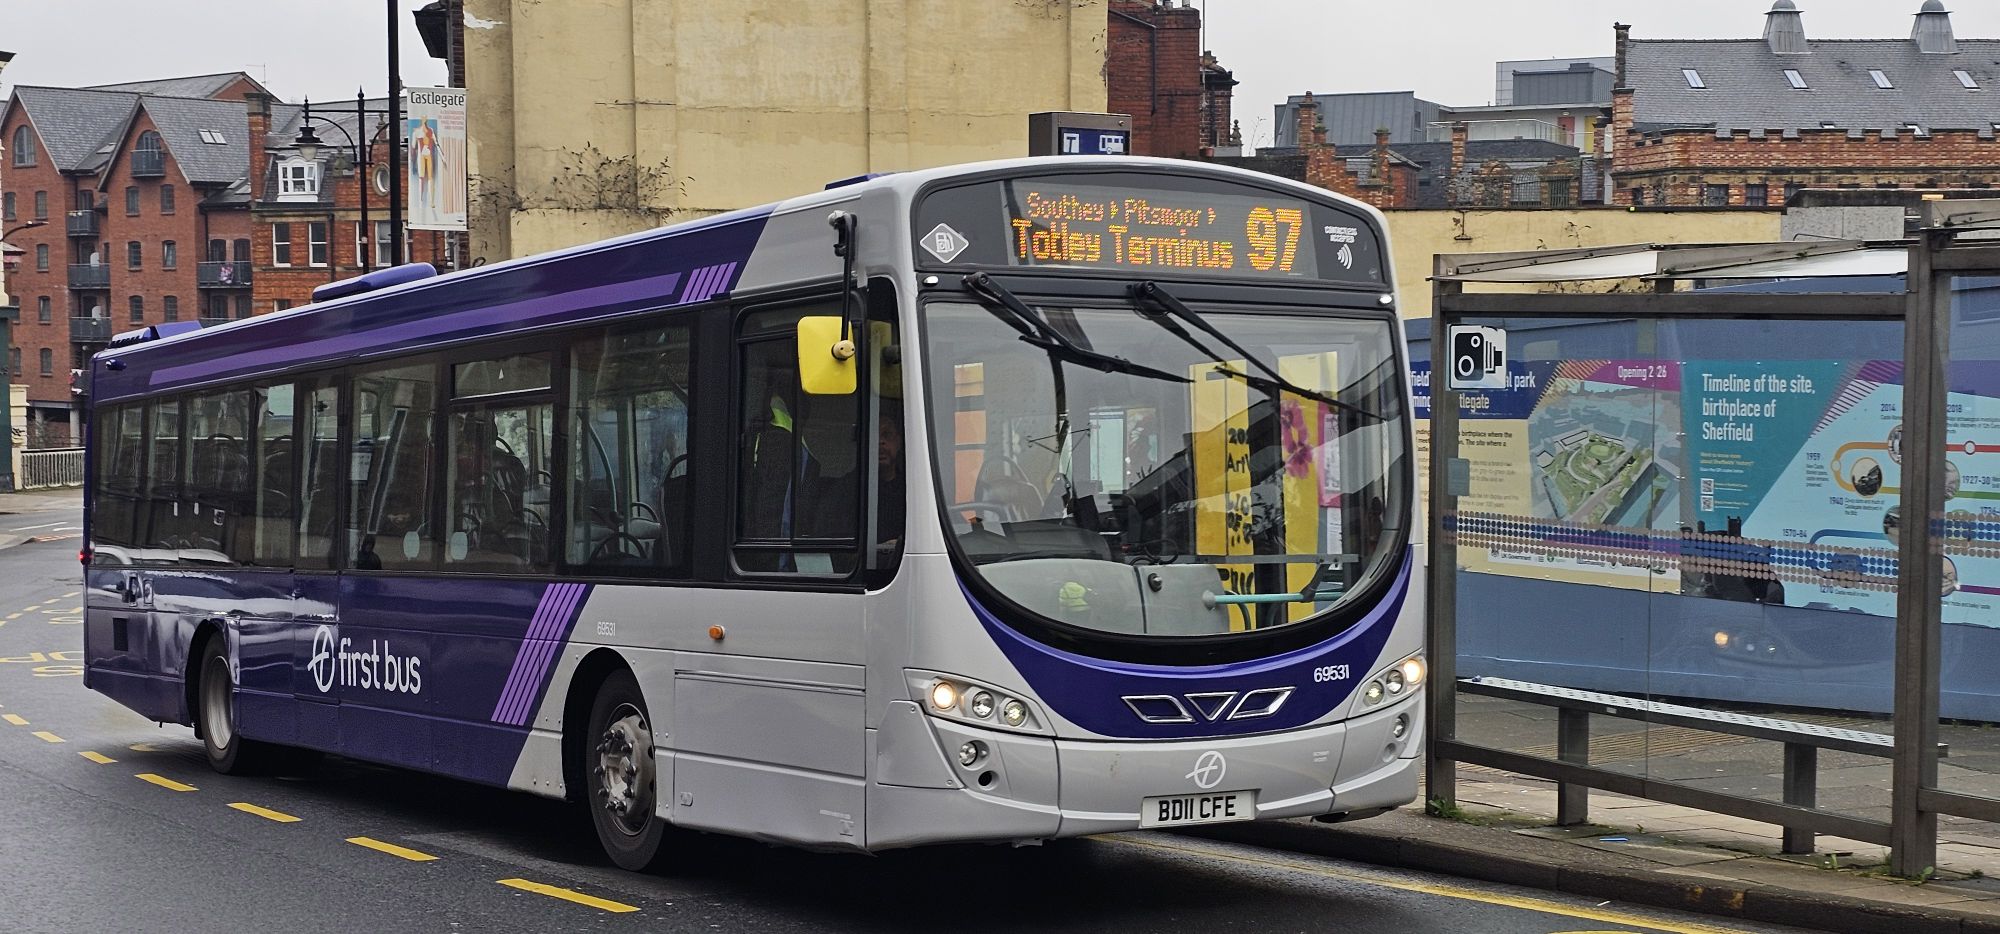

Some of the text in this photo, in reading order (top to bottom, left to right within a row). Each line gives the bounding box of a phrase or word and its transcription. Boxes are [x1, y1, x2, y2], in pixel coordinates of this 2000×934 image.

[411, 91, 465, 108] Castlegate
[1028, 192, 1202, 227] Southey Pitsmoor
[1012, 218, 1234, 269] Totley Terminus
[1246, 207, 1302, 271] 97
[1514, 371, 1536, 392] park
[1618, 365, 1667, 381] Opening 226
[1702, 373, 1815, 395] Timeline of the site,
[1459, 393, 1490, 413] tlegate
[1702, 398, 1776, 421] birthplace of
[1880, 403, 1896, 412] 2014
[1702, 421, 1753, 441] Sheffield
[597, 621, 616, 638] 69531
[338, 637, 421, 695] first bus
[1313, 664, 1350, 683] 69531
[1158, 795, 1237, 823] BD11 CFE
